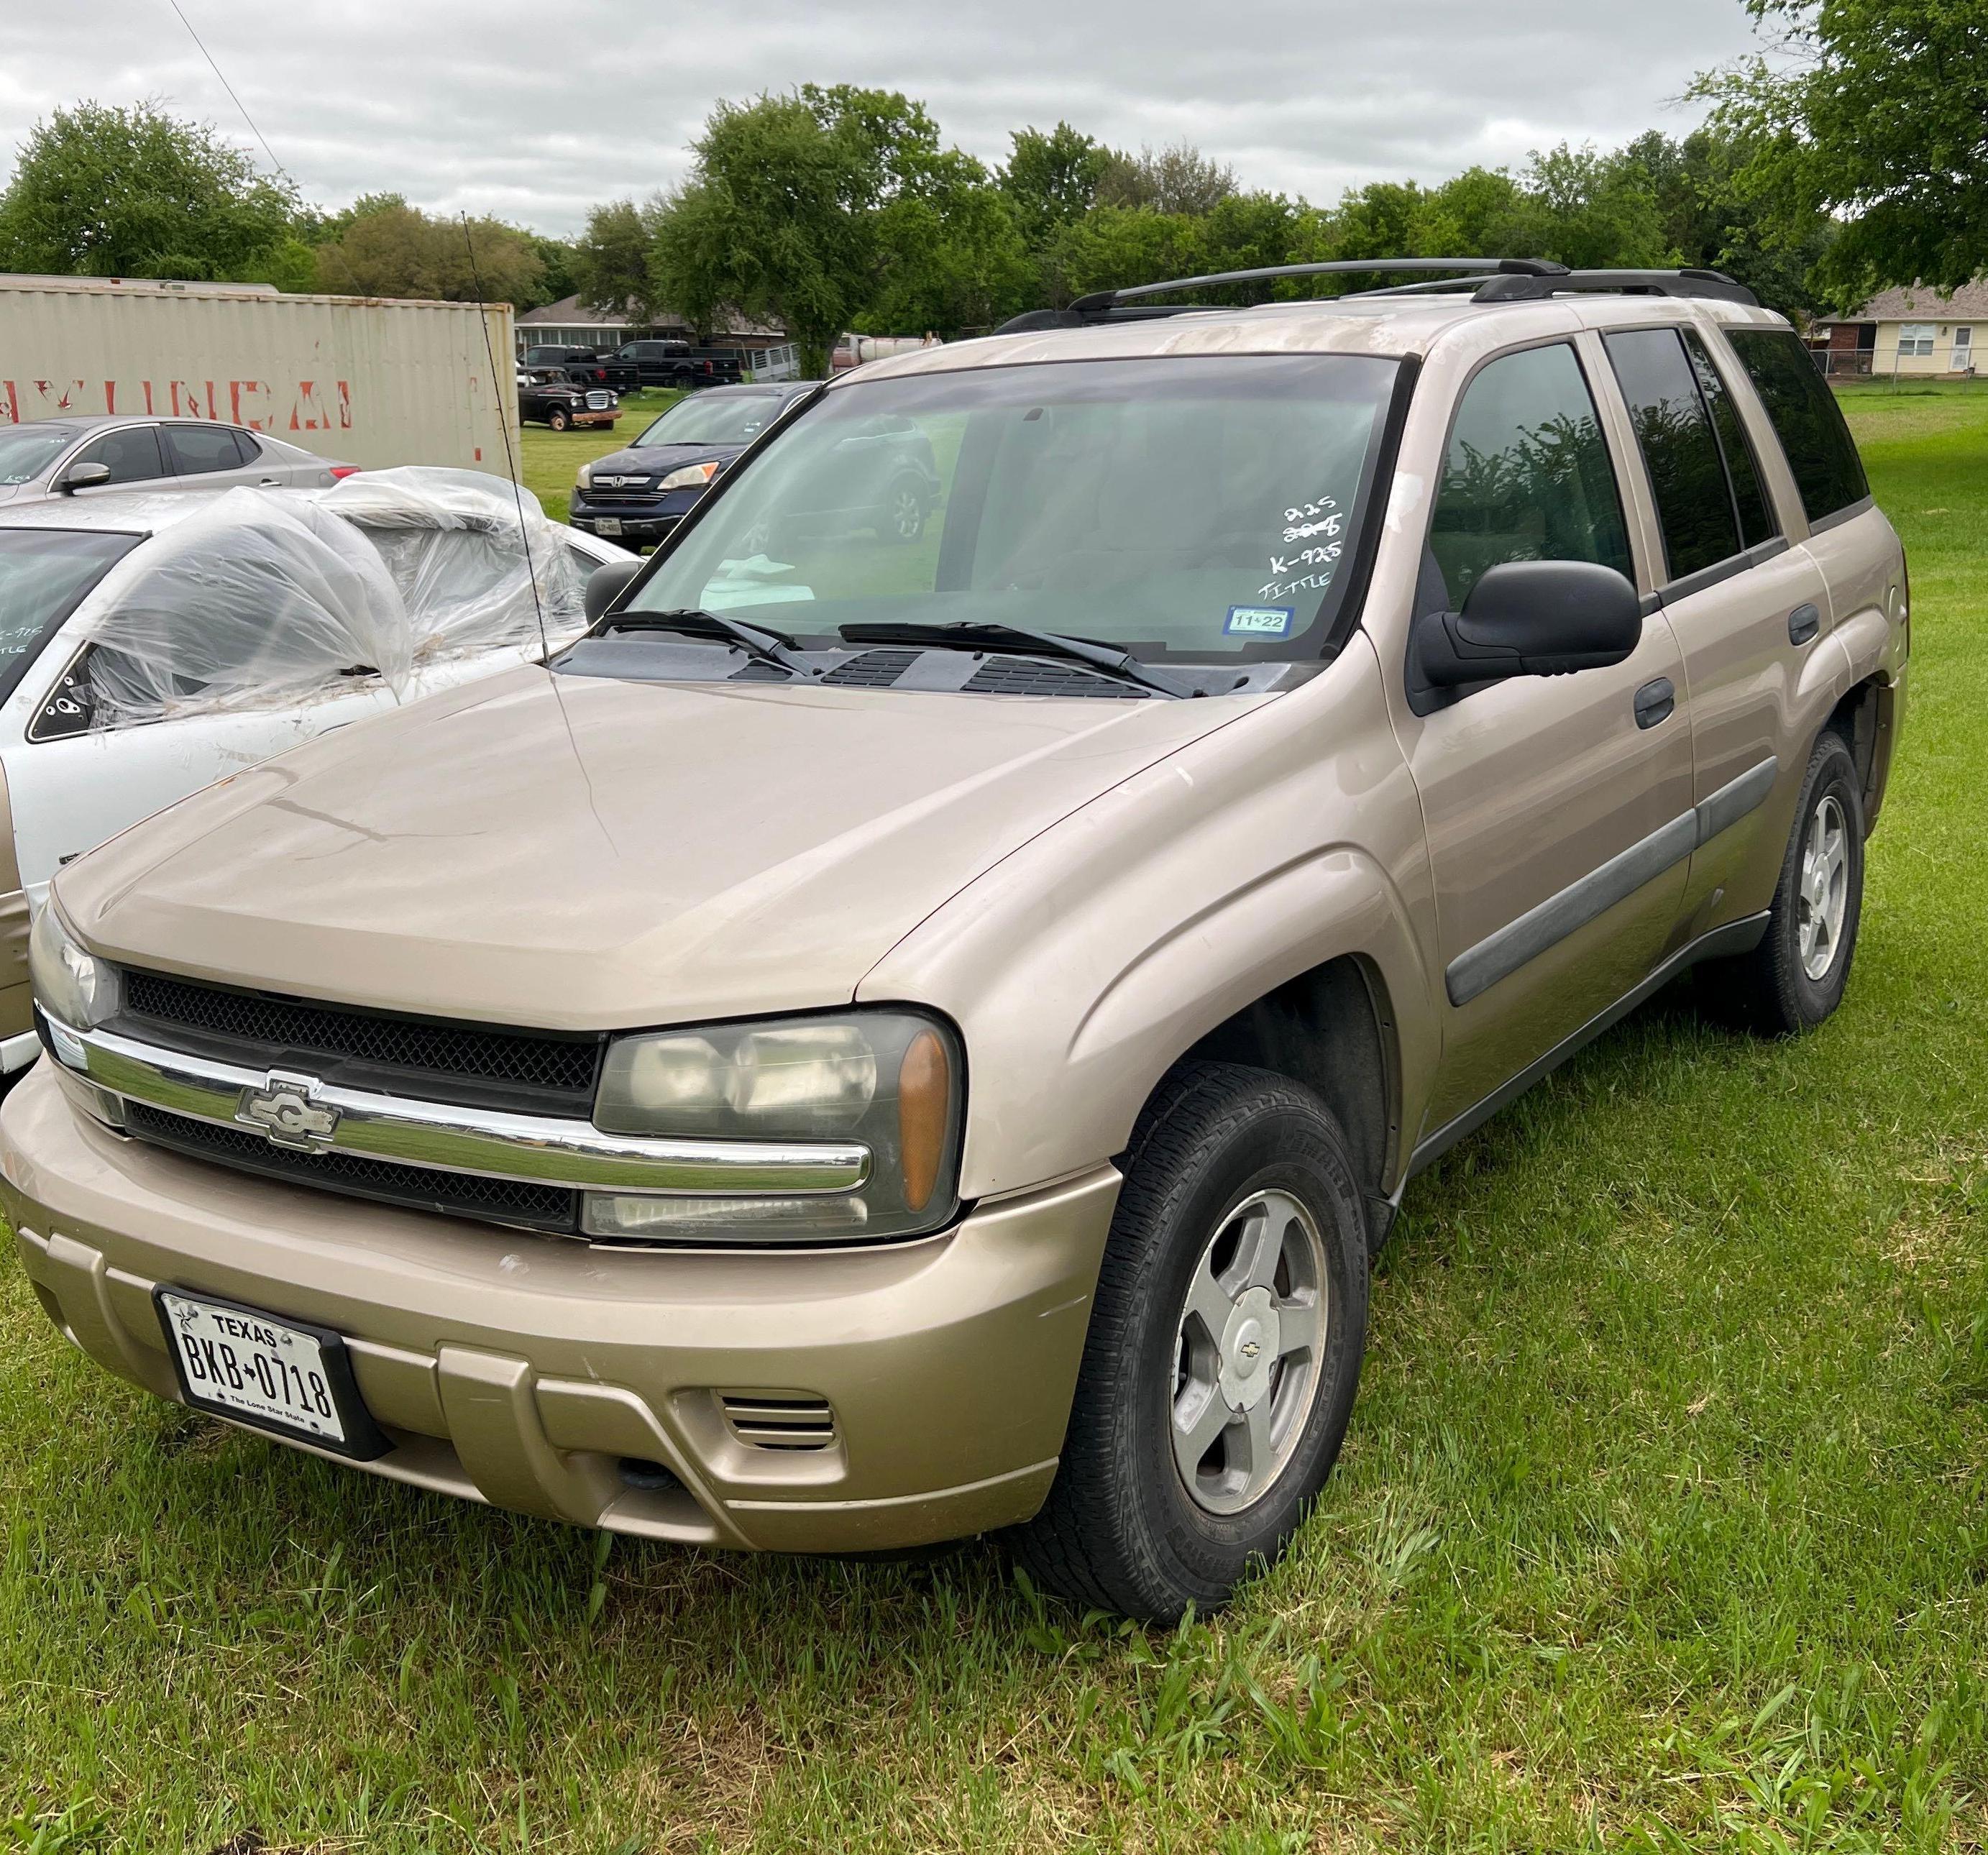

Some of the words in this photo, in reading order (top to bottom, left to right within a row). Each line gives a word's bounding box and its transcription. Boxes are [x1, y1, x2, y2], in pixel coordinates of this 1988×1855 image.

[1269, 540, 1342, 574] K-925
[211, 1314, 278, 1348] TEXAS
[230, 1395, 245, 1404] The
[247, 1400, 266, 1411] Lone
[267, 1406, 283, 1416] Star
[285, 1411, 305, 1423] State
